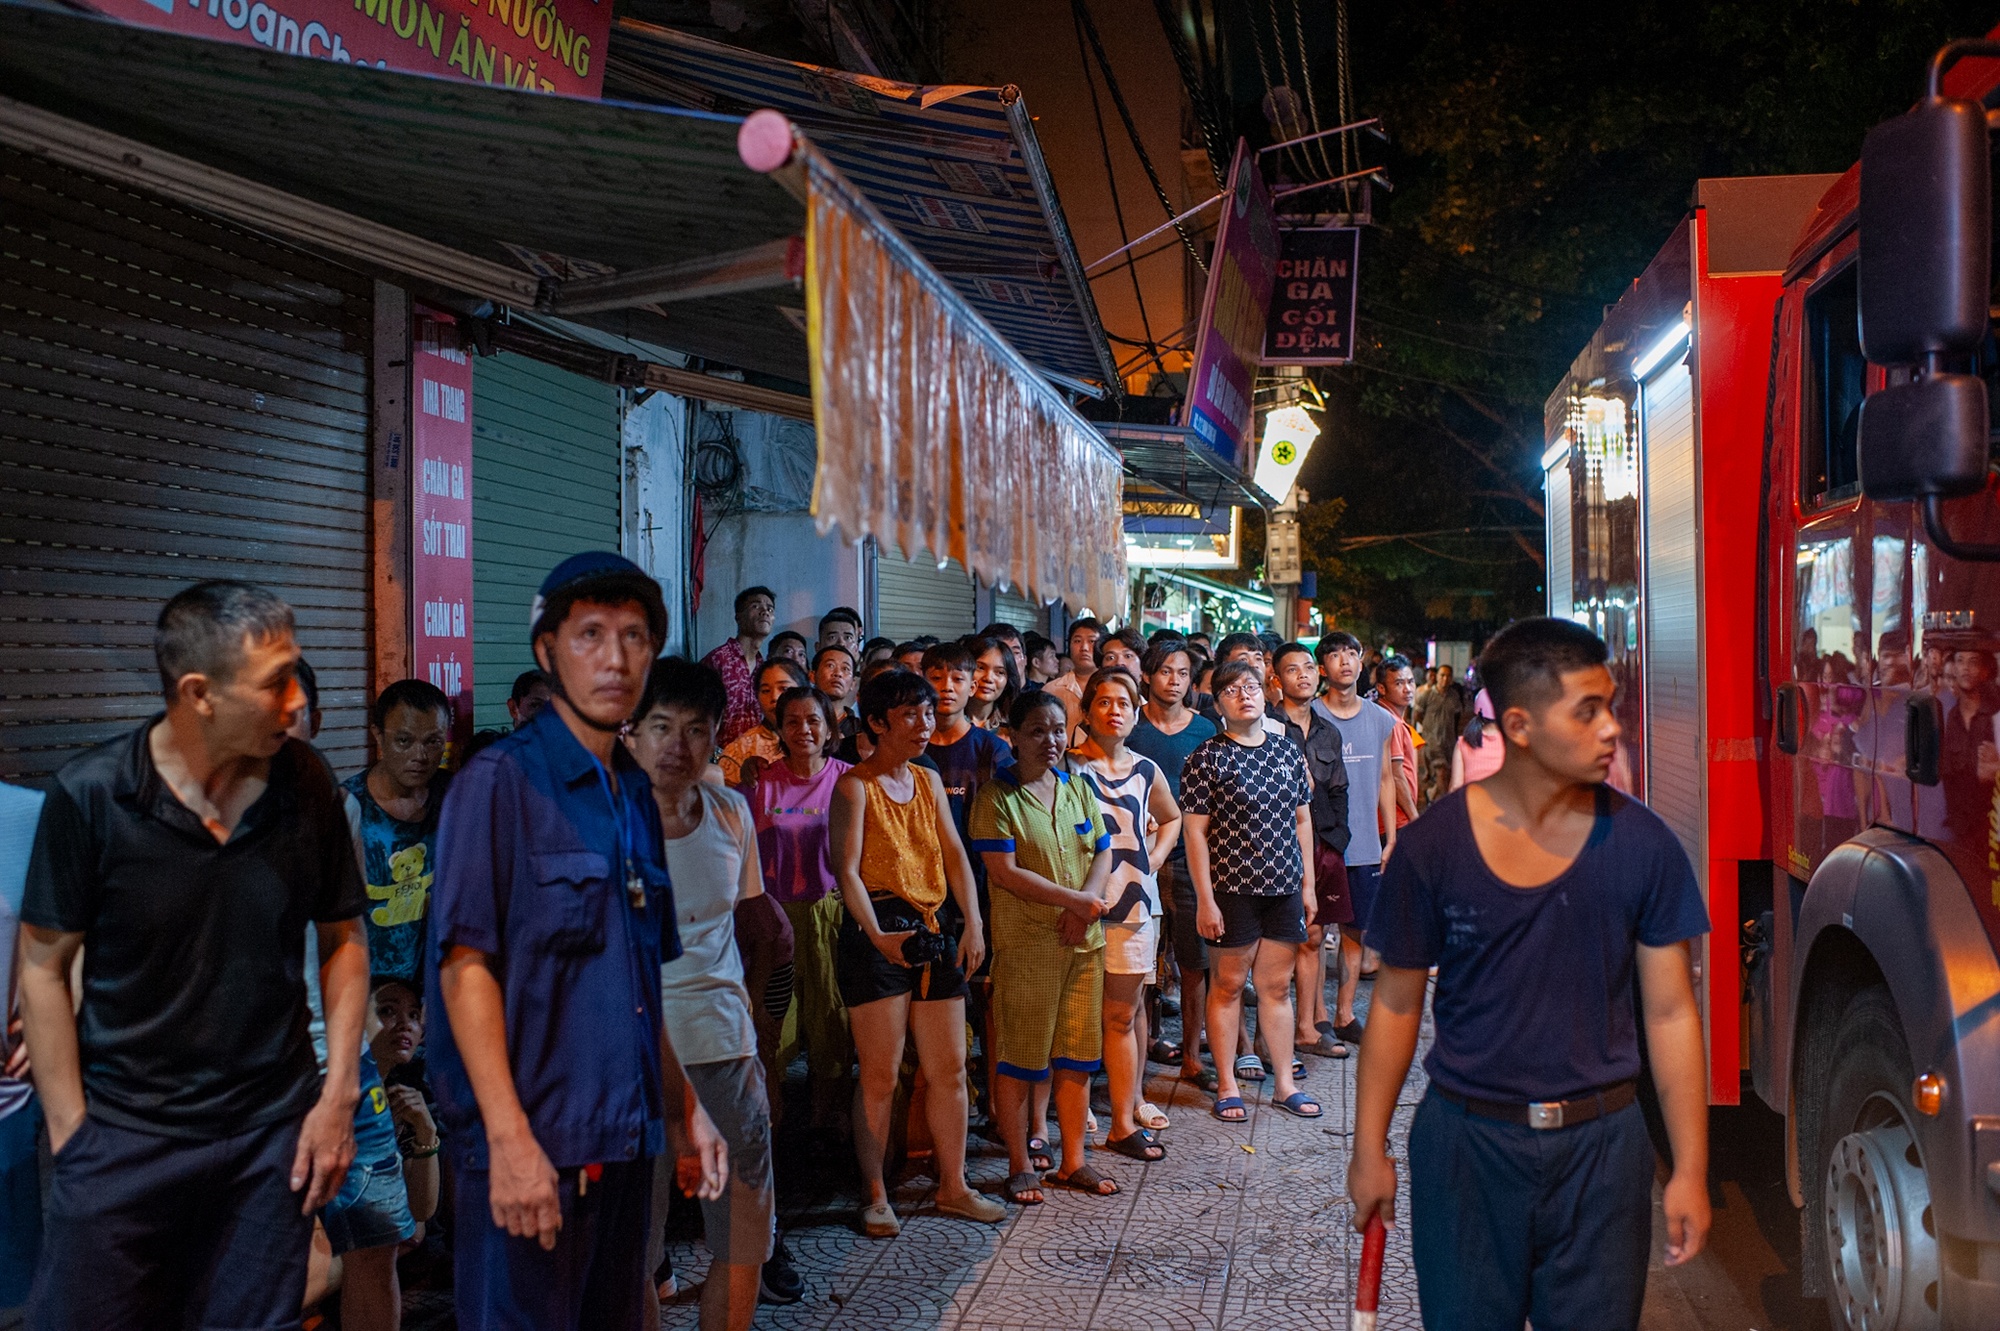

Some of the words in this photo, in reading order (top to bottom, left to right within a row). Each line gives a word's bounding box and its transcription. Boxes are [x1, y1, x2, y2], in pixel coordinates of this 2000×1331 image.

[447, 14, 497, 86] ĂN
[1277, 256, 1347, 279] CHĂN
[1286, 281, 1333, 300] GA
[1281, 302, 1337, 326] GỐI
[1275, 326, 1341, 354] ĐỆM
[440, 383, 466, 423] TRANG
[423, 458, 448, 496] CHÂN
[452, 461, 465, 501] GÀ
[423, 507, 443, 555] SỐT
[444, 516, 466, 559] THÁI
[424, 596, 450, 638] CHÂN
[453, 598, 466, 638] GÀ
[444, 652, 462, 697] TẮC
